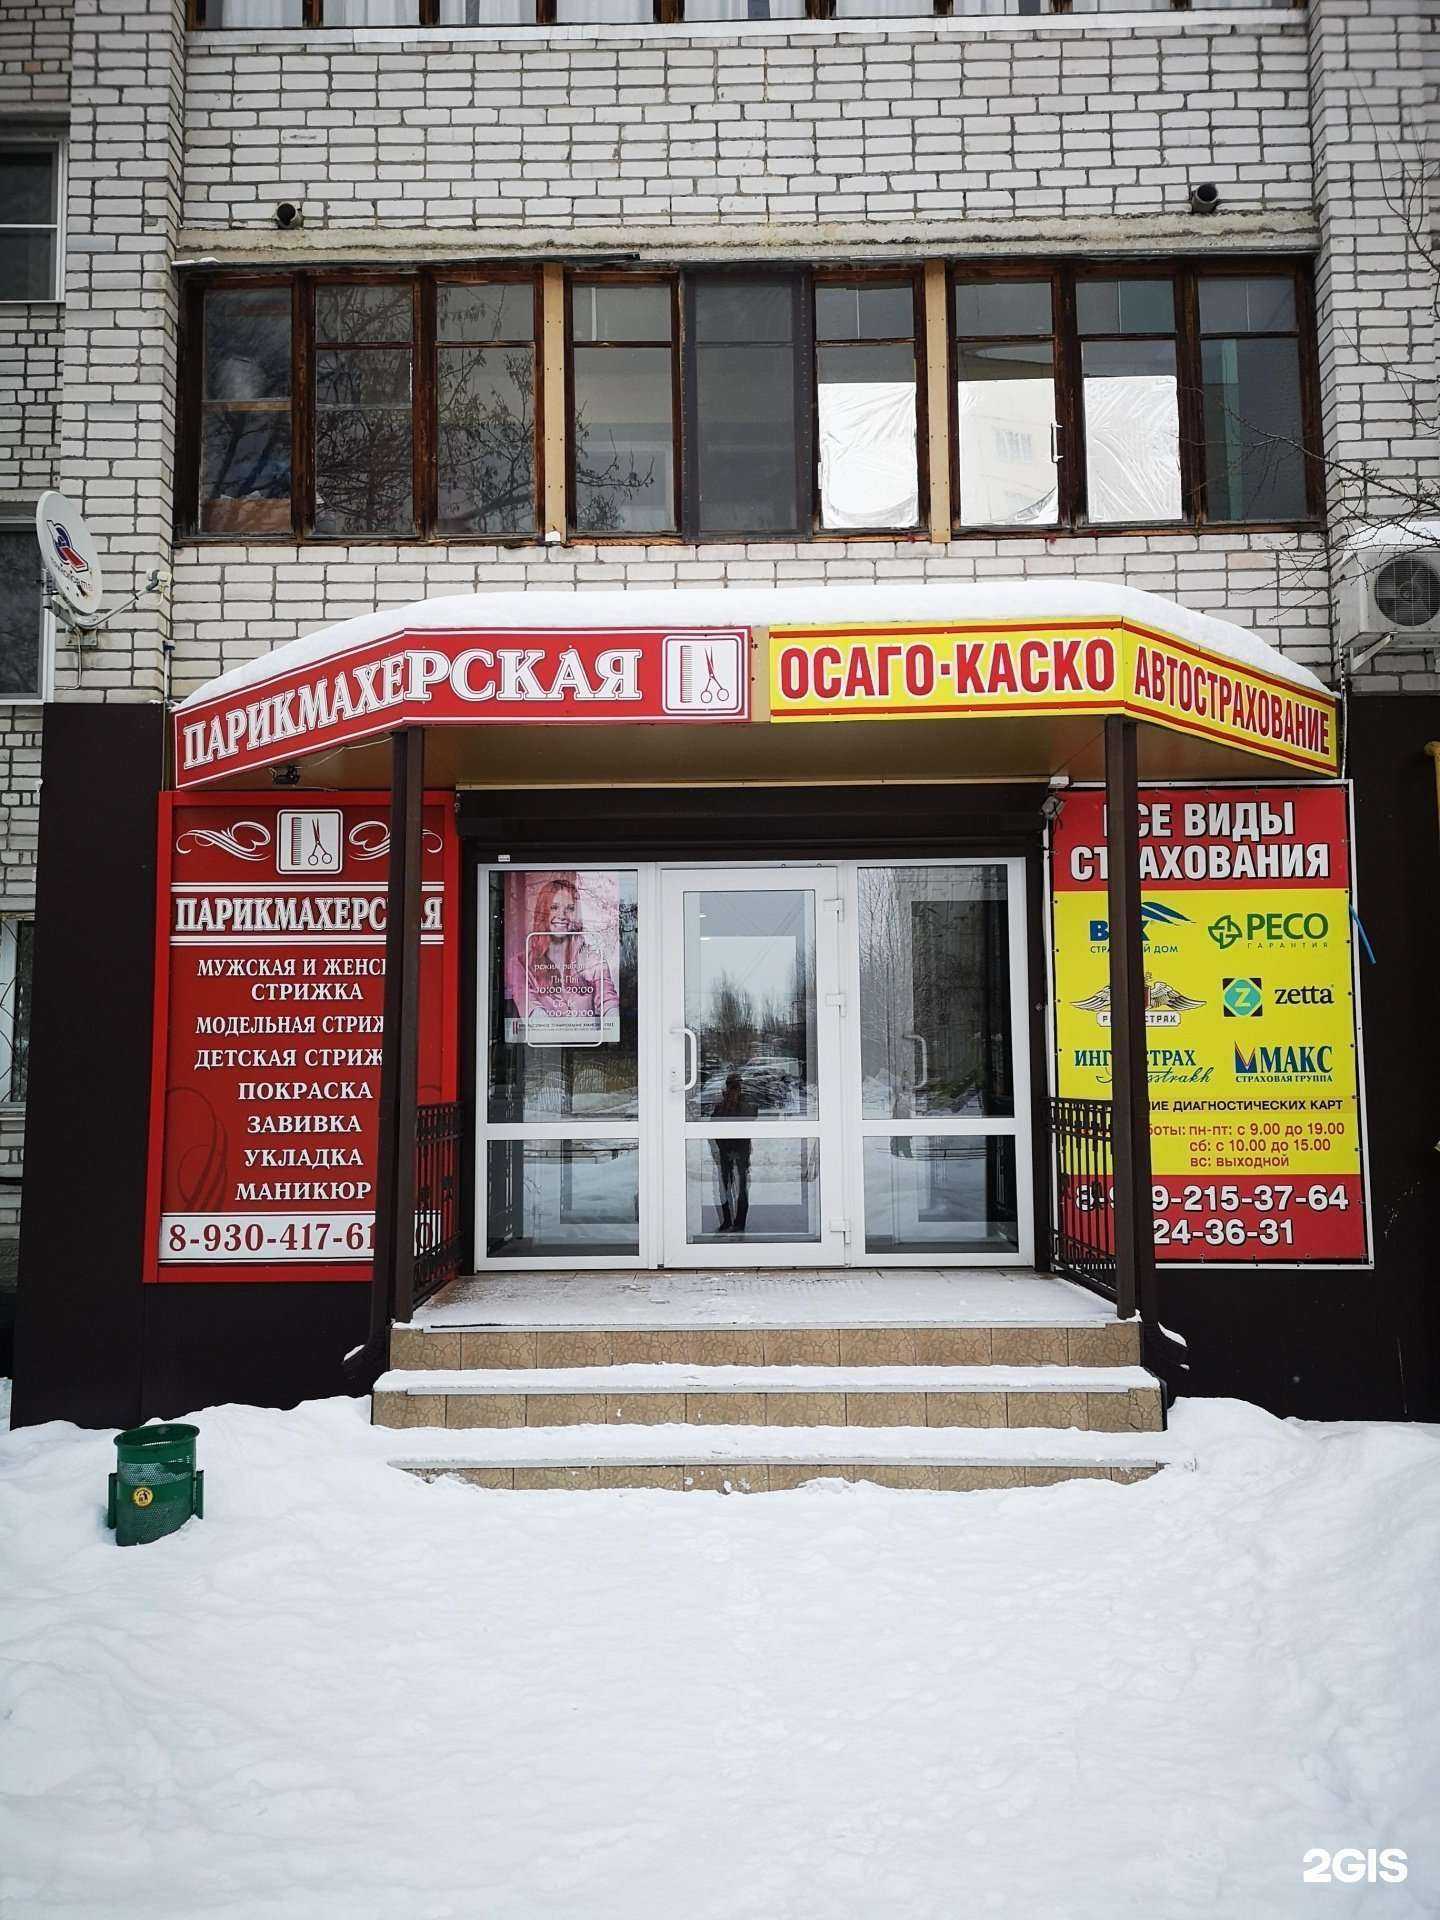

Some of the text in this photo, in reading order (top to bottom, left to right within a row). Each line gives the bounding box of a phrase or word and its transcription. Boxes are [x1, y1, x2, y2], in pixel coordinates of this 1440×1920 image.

[183, 648, 643, 770] ПАРИКМАХЕРСКАЯ
[1135, 646, 1330, 756] АВТОСТРАХОВАНИЕ
[1104, 801, 1295, 842] СЕ ВИДЫ
[1070, 844, 1329, 880] СТАХОВАНИЯ
[175, 897, 443, 932] ПАРИКМАХЕРСЯ
[1247, 912, 1328, 940] РЕСО
[1154, 945, 1178, 954] ДОМ
[197, 958, 386, 977] МУЖСКАЯ И ЖЕНС
[251, 983, 364, 1001] СТРИЖКА
[1274, 985, 1334, 1004] zetta
[196, 1016, 315, 1036] МОДЕЛЬНАЯ
[194, 1048, 383, 1070] ДЕТСКАЯ СТРИЖ
[1260, 1045, 1333, 1073] МАКС
[1235, 1075, 1333, 1083] СТРАХОВАЯ ГРУППА
[238, 1081, 373, 1101] ПОКРАСКА
[1173, 1100, 1306, 1112] ДИАГНОСТИЧЕСКИХ
[1310, 1100, 1343, 1110] КАРТ
[247, 1115, 362, 1133] ЗАВИВКА
[1250, 1123, 1280, 1135] 9.00
[1285, 1125, 1303, 1137] до
[1307, 1122, 1345, 1135] 19.00
[1189, 1140, 1211, 1152] сб:
[1230, 1139, 1266, 1151] 10.00
[1271, 1142, 1289, 1153] до
[1294, 1138, 1331, 1151] 15.00
[244, 1148, 363, 1169] УКЛАДКА
[1190, 1154, 1289, 1168] вс: выходной
[235, 1182, 371, 1201] МАНИКЮР
